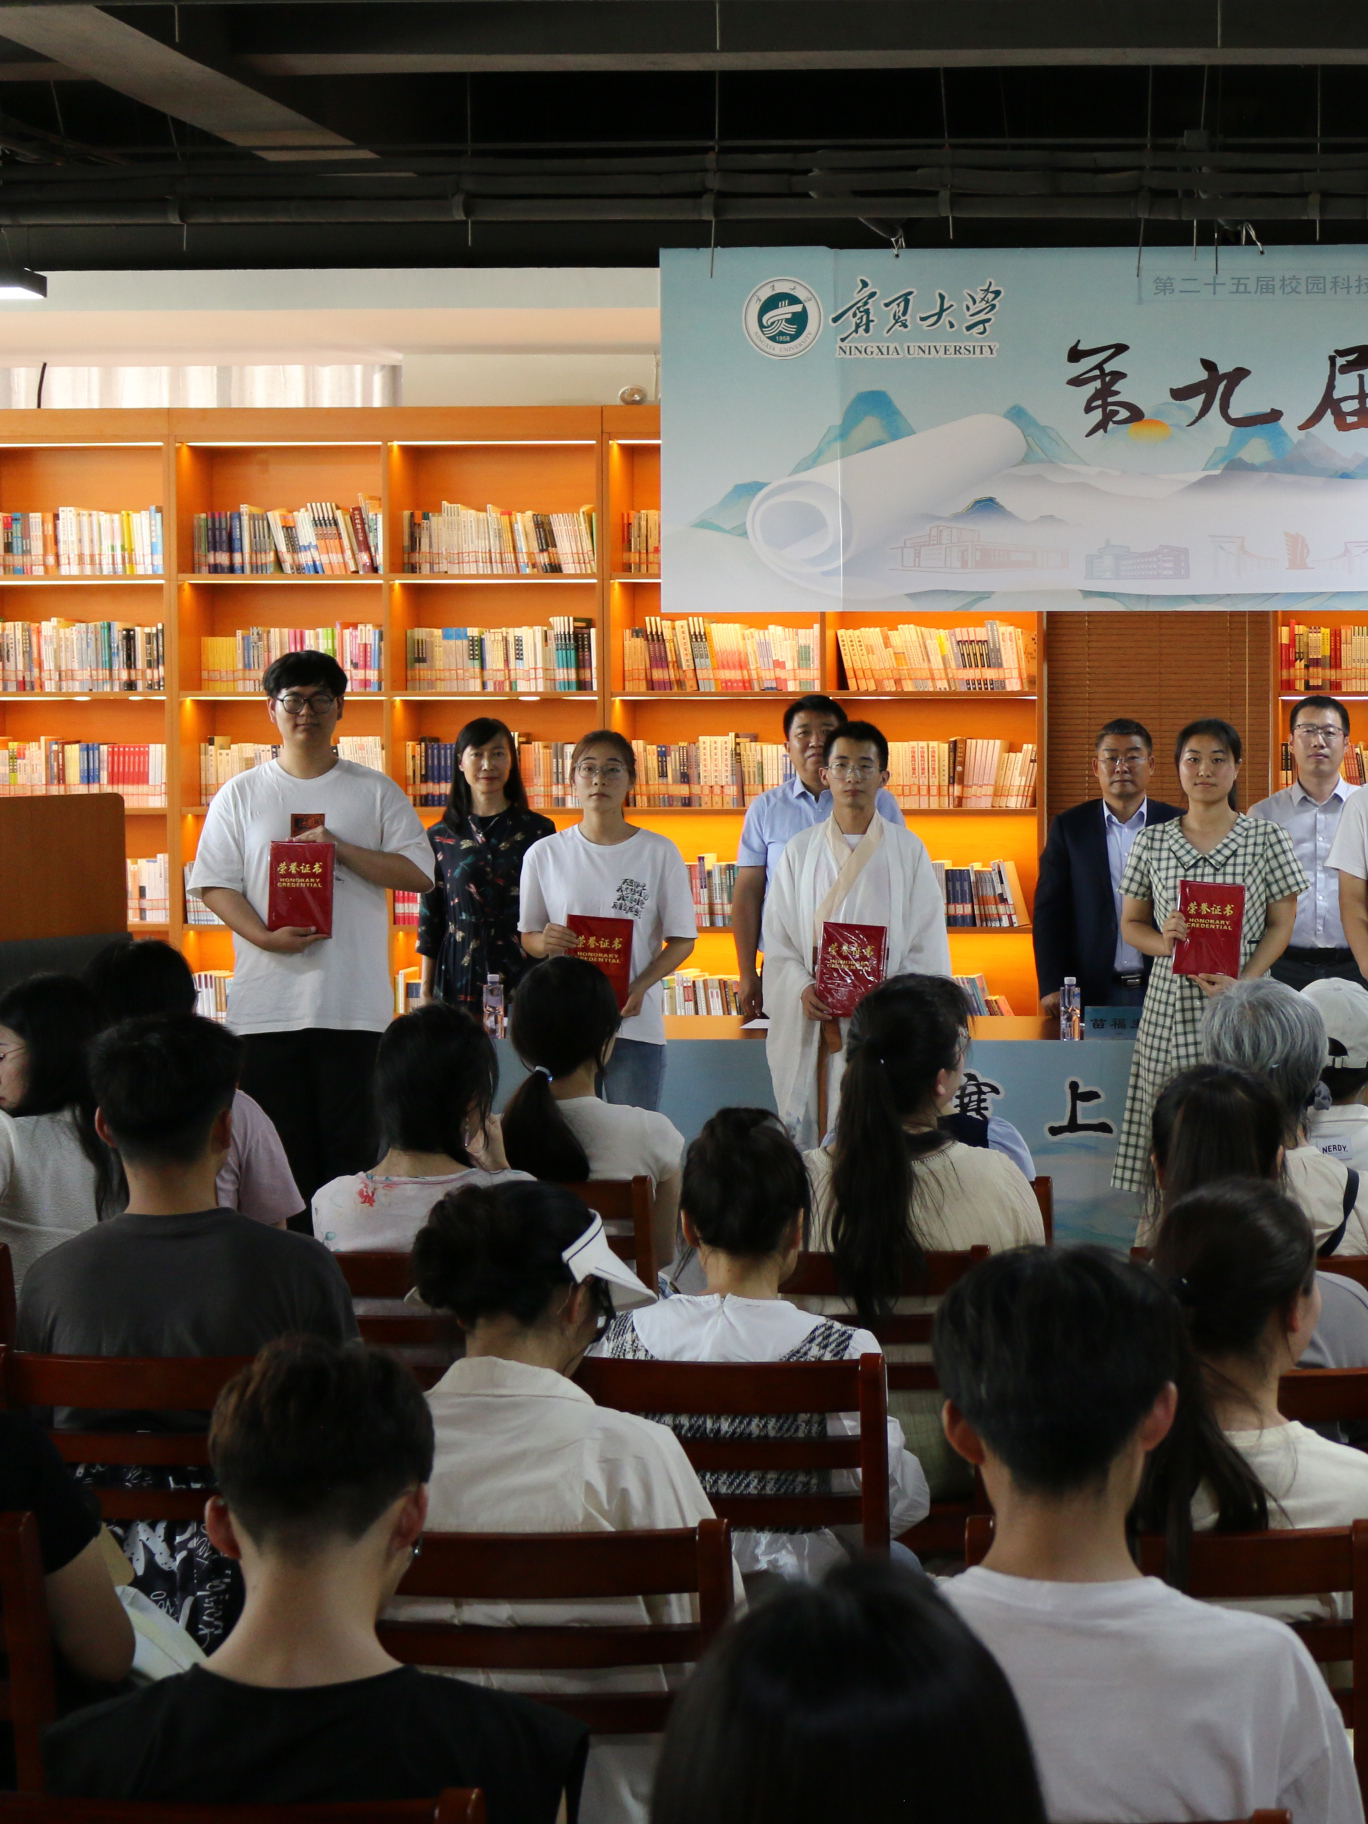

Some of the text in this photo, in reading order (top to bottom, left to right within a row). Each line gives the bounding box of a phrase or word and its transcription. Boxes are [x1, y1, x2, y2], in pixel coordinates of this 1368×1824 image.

[837, 344, 998, 356] NINGXIA UNIVERSITY
[277, 862, 323, 875] 荣誉证书
[1187, 901, 1235, 917] 荣誉证书
[1187, 923, 1233, 931] CREDENTIAL
[577, 951, 619, 959] HONORARY
[1322, 1144, 1347, 1154] NERDY
